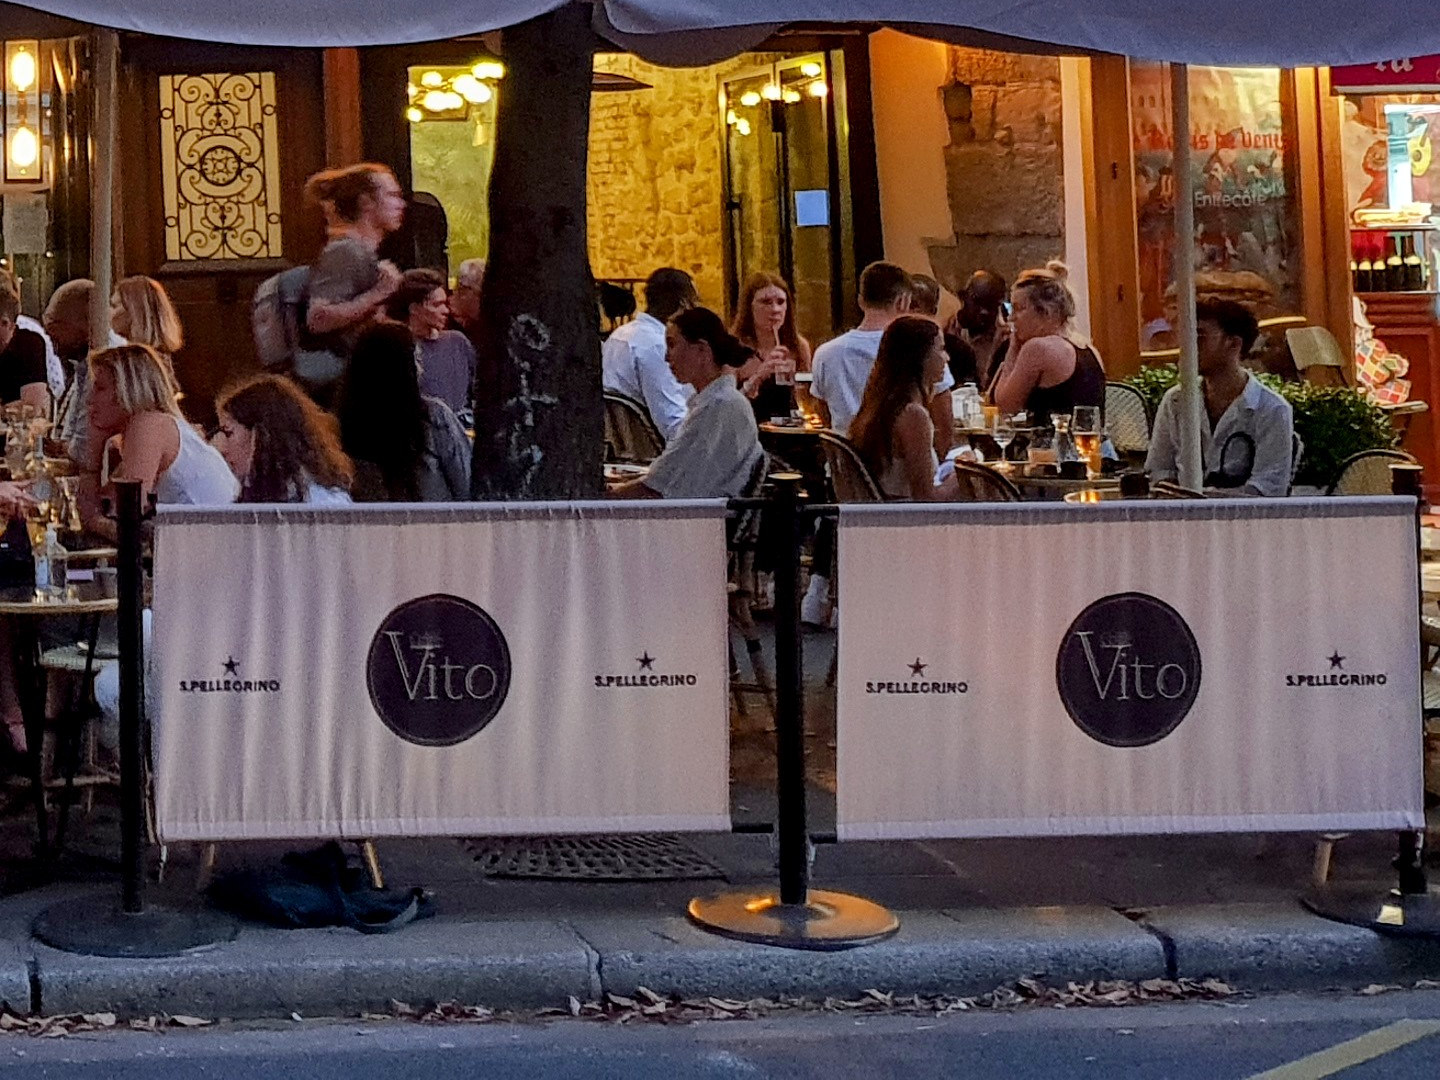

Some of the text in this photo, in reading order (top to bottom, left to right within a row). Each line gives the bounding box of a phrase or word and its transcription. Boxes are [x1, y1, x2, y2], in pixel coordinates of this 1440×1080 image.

[382, 631, 497, 700] Vito
[1074, 631, 1187, 700] Vito
[179, 680, 280, 692] S.PELLEGRINO
[594, 674, 697, 687] S.PELLEGRINO
[1286, 674, 1387, 686] S.PELLEGRINO
[866, 682, 968, 694] S.PELLEGRINO
